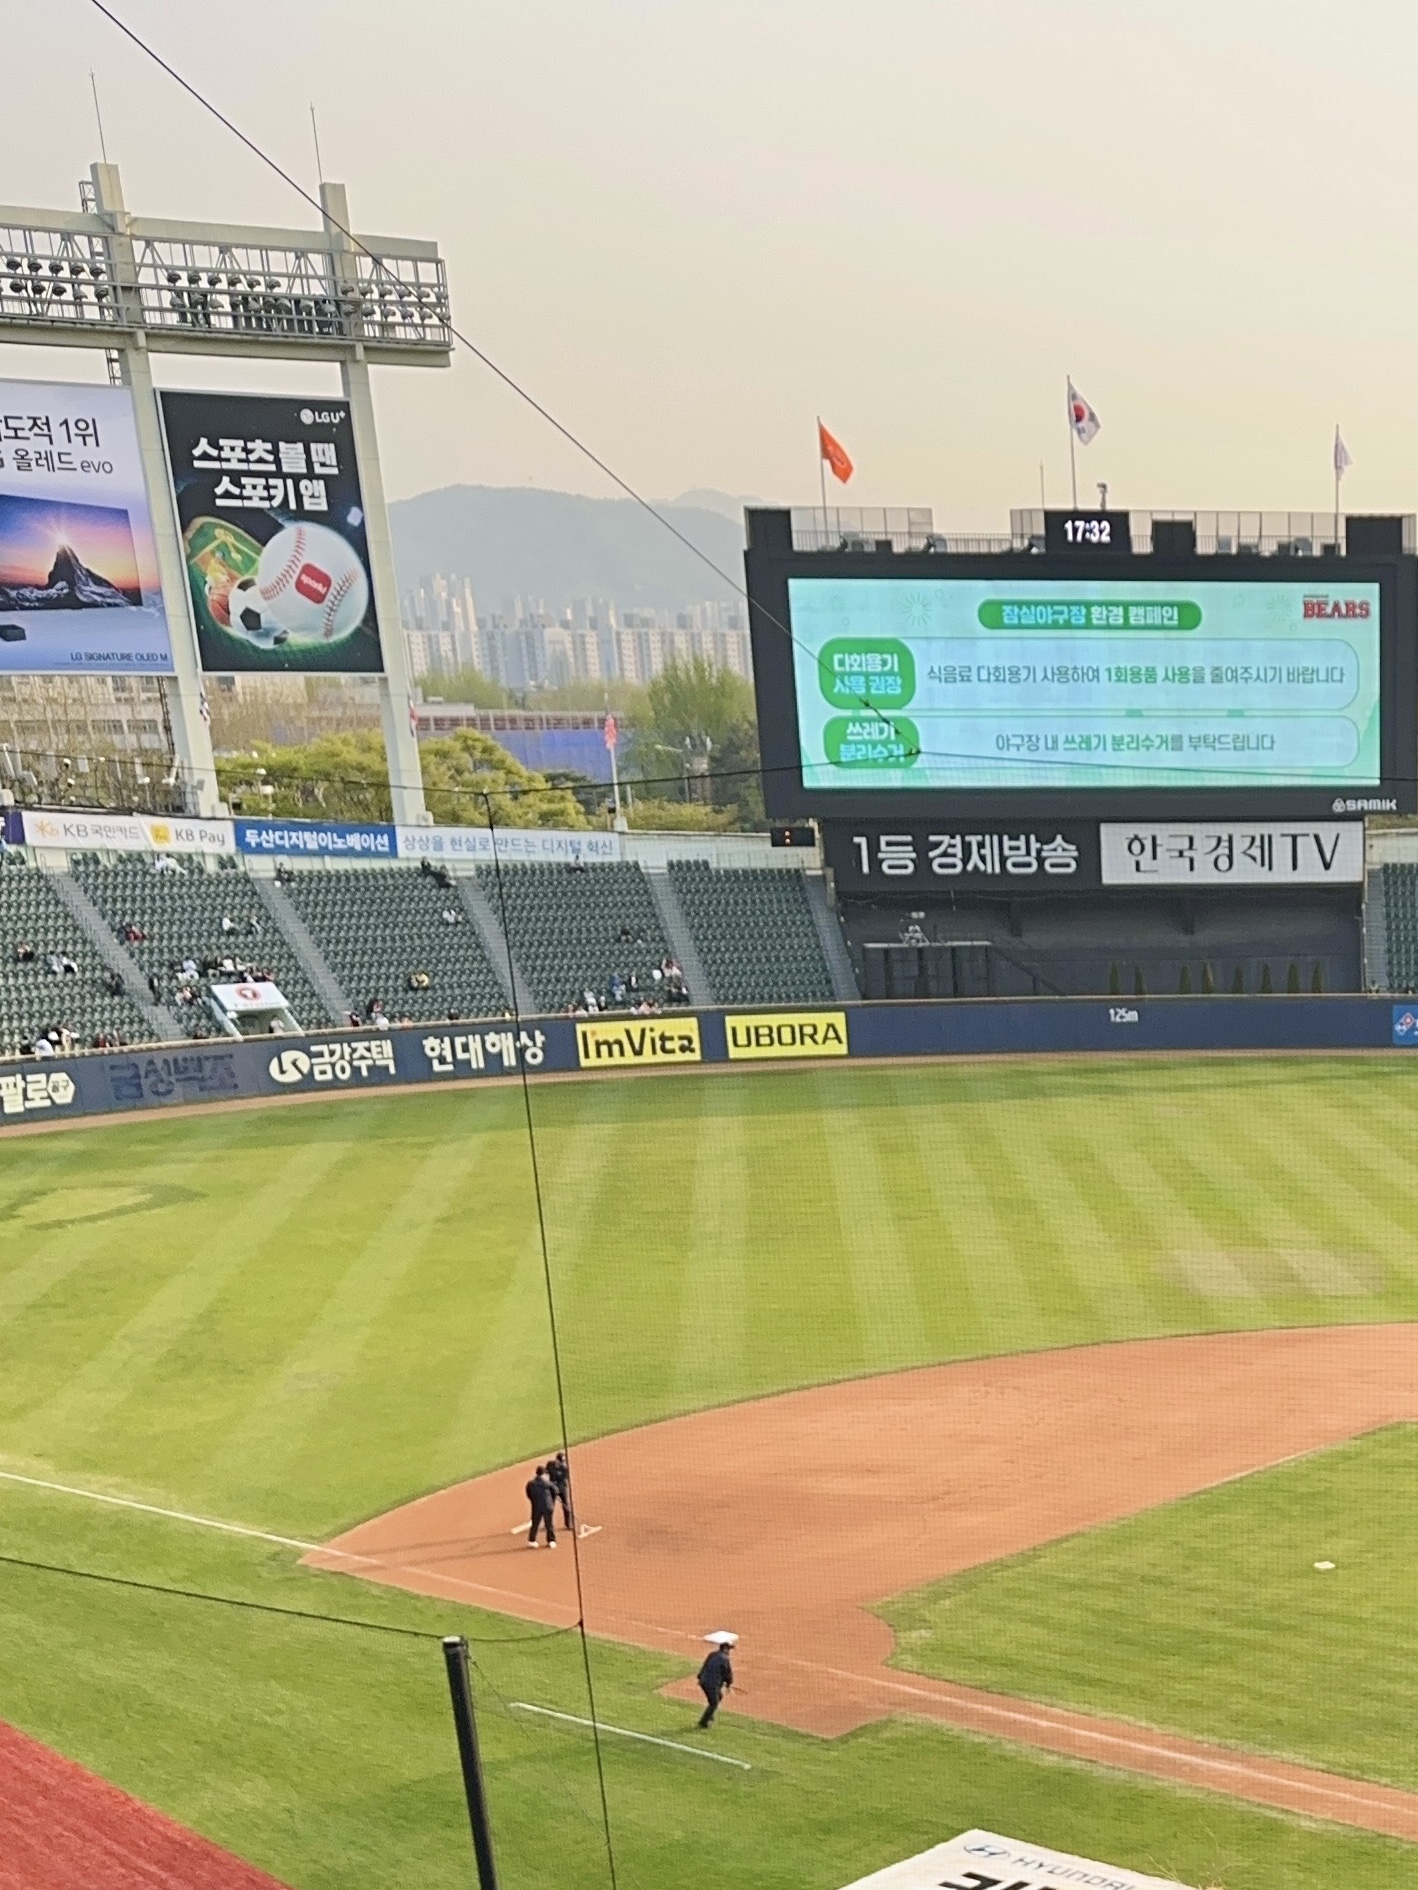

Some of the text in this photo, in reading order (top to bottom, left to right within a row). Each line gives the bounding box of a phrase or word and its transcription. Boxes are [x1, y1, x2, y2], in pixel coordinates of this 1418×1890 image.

[0, 414, 100, 447] 도적 1위
[12, 448, 77, 473] 올레드
[80, 458, 113, 474] evo
[191, 437, 339, 475] 스포츠 볼 땐
[214, 475, 328, 511] 스포키 앱
[1064, 519, 1111, 543] 17:32
[1001, 604, 1178, 625] 잠실야구장 환경 캠페인
[1302, 600, 1370, 620] BEARS
[70, 652, 82, 661] LG
[84, 652, 133, 662] SIGNATURE
[135, 653, 159, 662] OLED
[833, 653, 898, 672] 다회용기
[833, 676, 866, 694] 사용
[927, 665, 1345, 685] 식음료 다회용기 사용하여 1회용품 사용을 줄여주시기 바랍니다
[847, 722, 895, 740] 쓰레기
[996, 733, 1275, 752] 야구장 내 쓰레기 분리수거를 부탁드립니다
[1346, 799, 1397, 811] SAMIK
[175, 828, 195, 840] KB
[199, 829, 225, 845] Pay
[245, 829, 389, 853] 두산디지털이노베이션
[402, 834, 444, 853] 상상을
[449, 834, 490, 854] 현실로
[495, 836, 537, 854] 만드는
[541, 837, 582, 855] 디지털
[852, 834, 1080, 876] 1등 경제방송
[1126, 832, 1341, 874] 한국경제TV
[1108, 1008, 1139, 1023] 125m
[731, 1022, 844, 1048] UBORA
[310, 1039, 396, 1082] 금강주택
[422, 1029, 546, 1073] 현대해상
